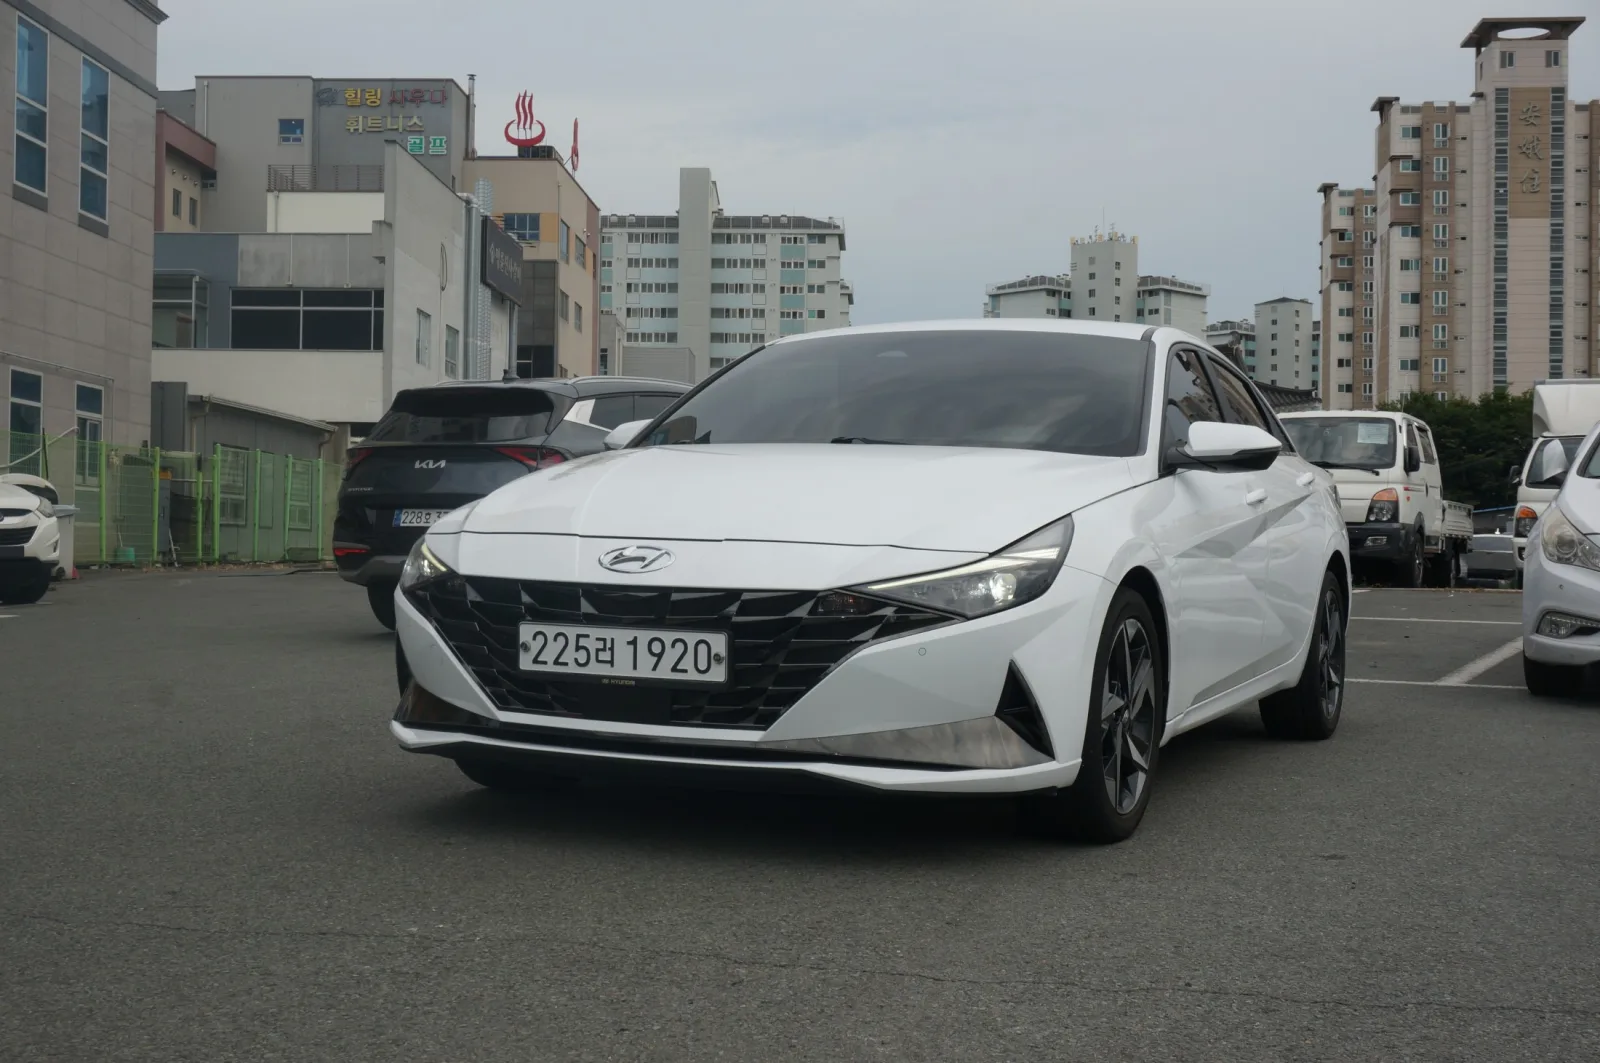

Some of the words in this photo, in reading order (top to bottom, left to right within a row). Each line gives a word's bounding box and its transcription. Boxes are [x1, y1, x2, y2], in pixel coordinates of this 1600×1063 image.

[344, 88, 382, 107] 힐링
[388, 88, 448, 107] 사우나
[346, 115, 425, 133] 휘트니스
[407, 135, 447, 155] 골프
[402, 511, 431, 525] 228호
[531, 630, 615, 668] 225러
[626, 635, 712, 675] 1920
